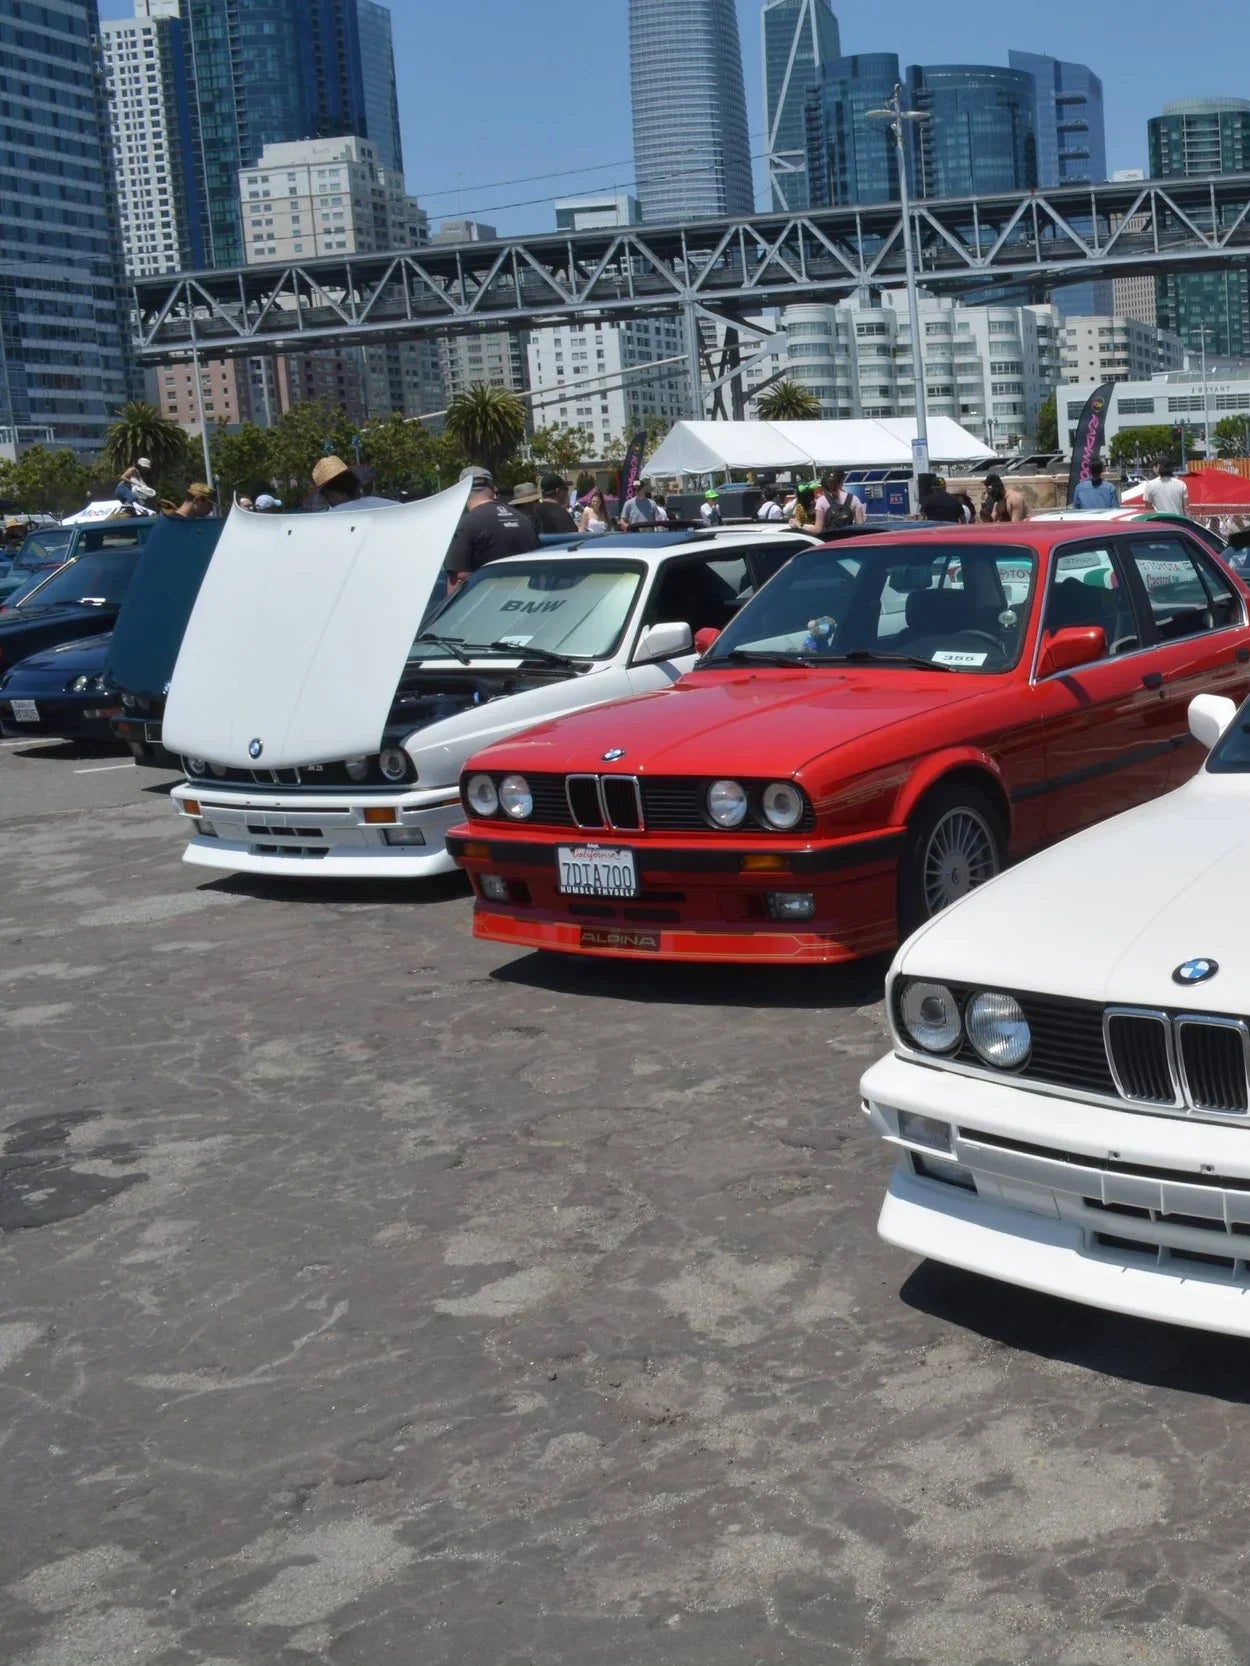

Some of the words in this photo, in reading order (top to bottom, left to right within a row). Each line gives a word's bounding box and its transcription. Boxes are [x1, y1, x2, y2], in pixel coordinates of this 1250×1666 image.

[1080, 414, 1099, 481] RADWOO
[500, 600, 567, 614] BMW
[562, 862, 633, 888] 7DIA700
[560, 885, 595, 895] HUMBLE
[598, 887, 635, 897] THYSELF
[582, 932, 657, 947] ALPINA
